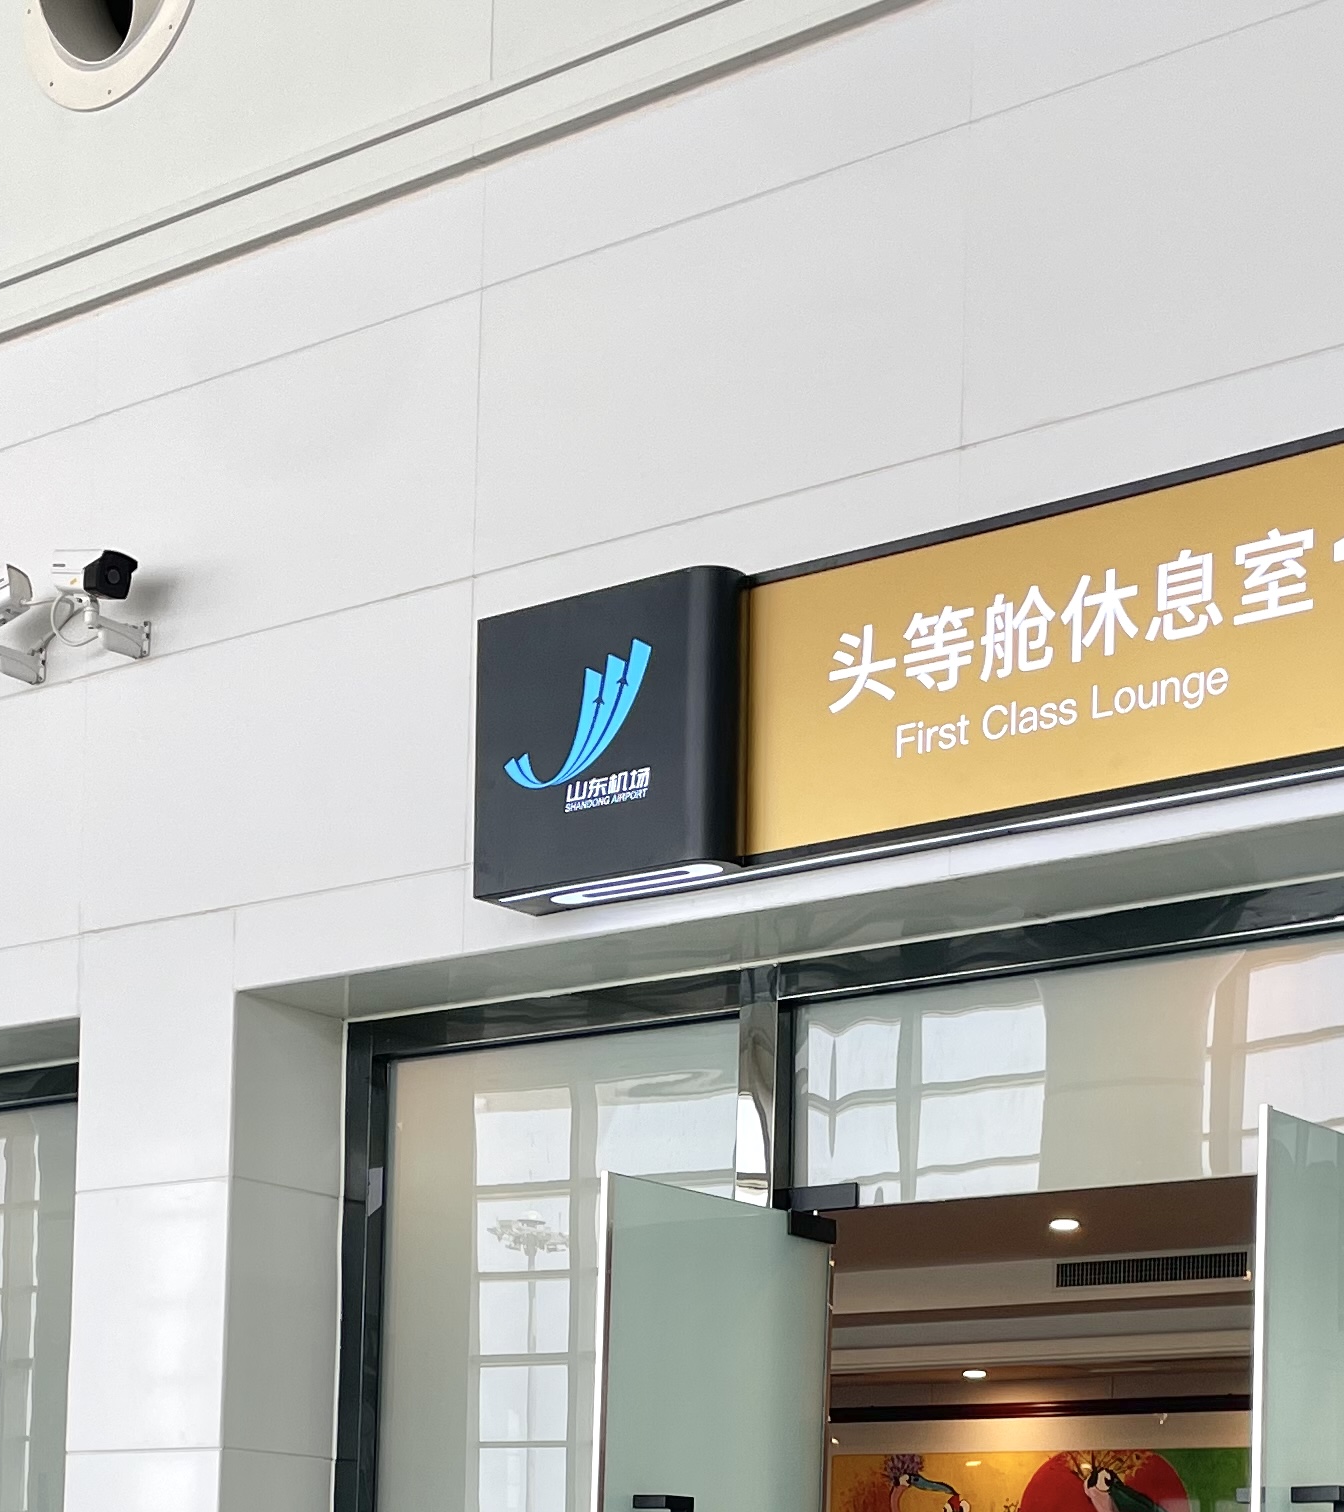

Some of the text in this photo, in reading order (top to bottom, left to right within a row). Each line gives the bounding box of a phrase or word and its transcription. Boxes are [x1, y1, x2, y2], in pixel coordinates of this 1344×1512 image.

[828, 527, 1314, 714] 头等舱休息室
[895, 668, 1230, 759] First Class Lounge
[565, 788, 648, 812] SHANDONG AIRPORT
[566, 767, 650, 802] 山东机场
